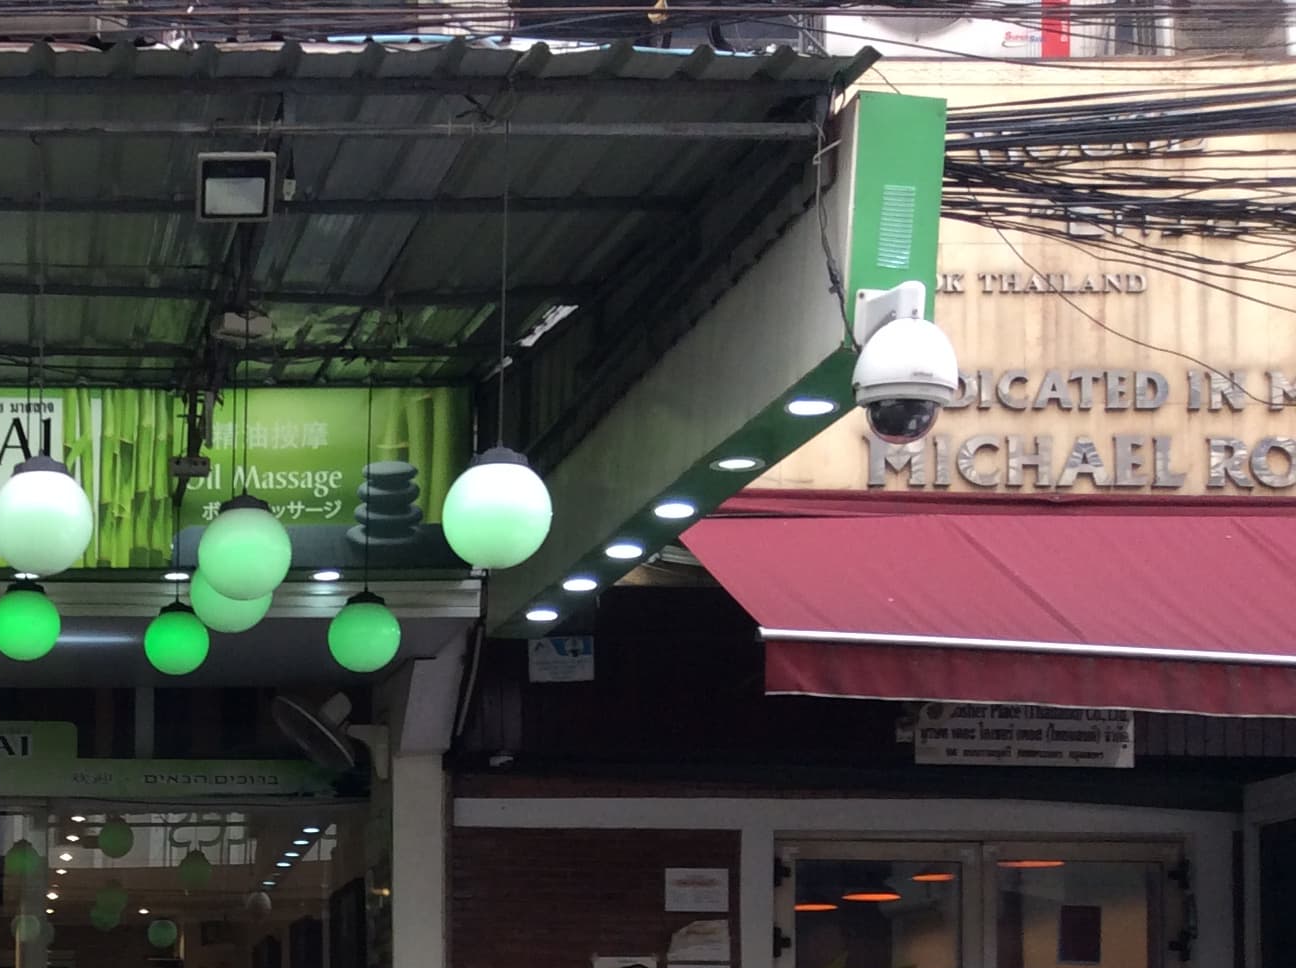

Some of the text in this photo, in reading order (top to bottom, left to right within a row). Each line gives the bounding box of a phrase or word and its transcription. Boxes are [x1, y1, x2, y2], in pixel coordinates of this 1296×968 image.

[977, 272, 1148, 294] THAILAND
[1187, 370, 1247, 412] IN
[864, 434, 1188, 490] MICHAEL
[234, 466, 343, 498] Massage
